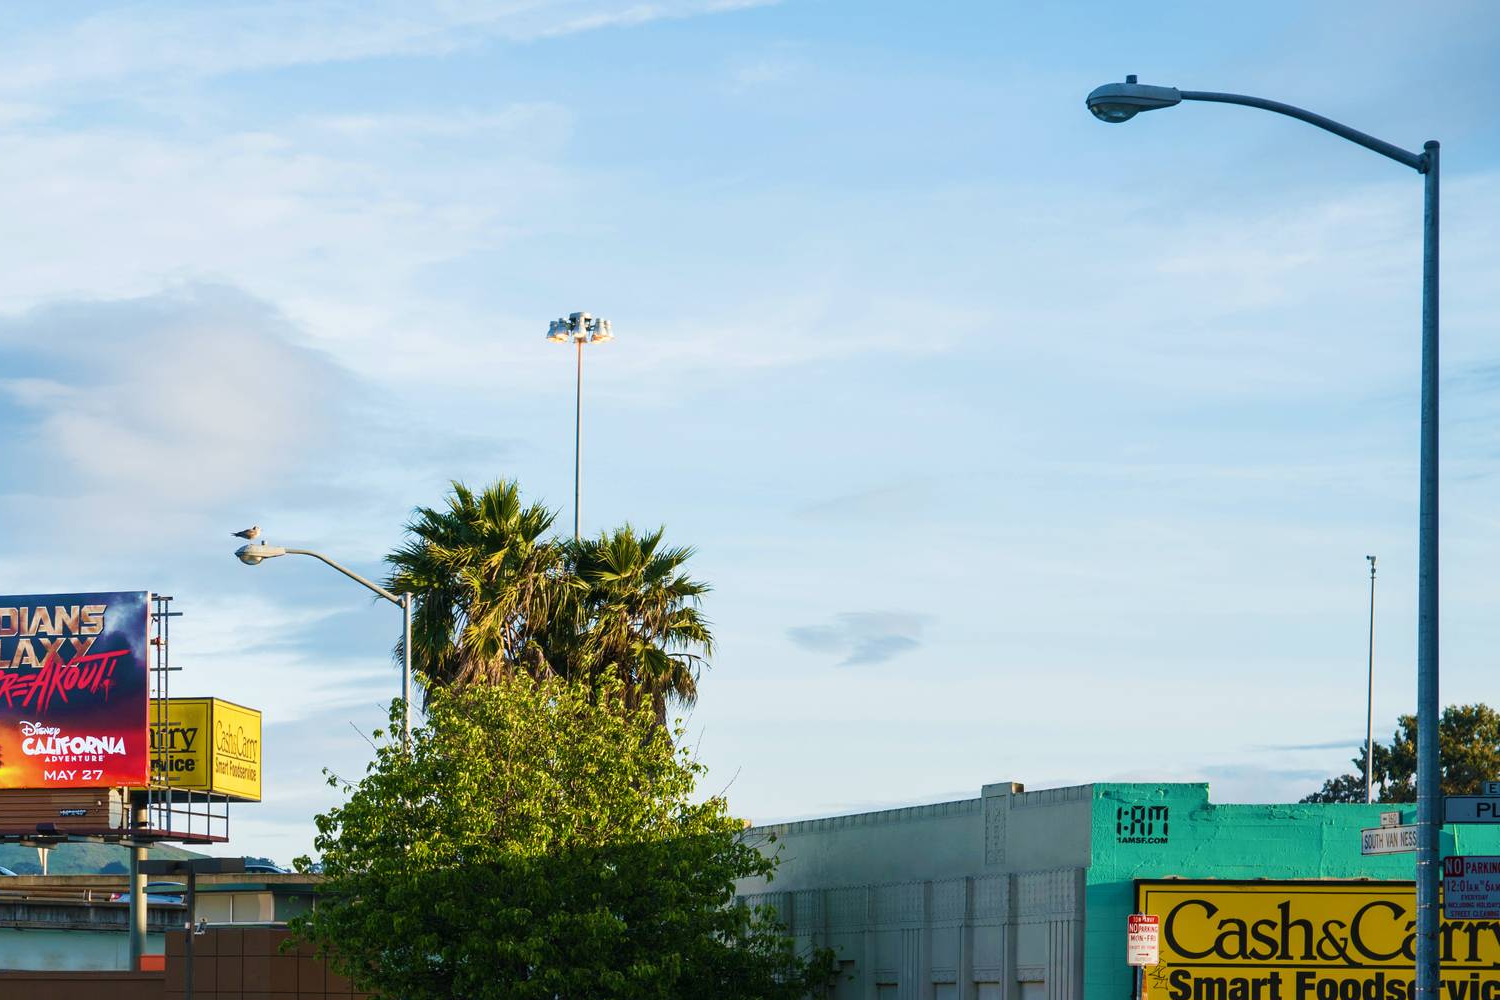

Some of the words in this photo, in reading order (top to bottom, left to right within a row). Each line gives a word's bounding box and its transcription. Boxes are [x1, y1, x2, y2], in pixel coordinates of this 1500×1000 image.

[22, 736, 126, 756] CALIFORNIA
[216, 720, 258, 762] Cash&Carry
[43, 770, 78, 780] MAY
[82, 769, 104, 780] 27
[1364, 832, 1384, 849] SOUTH
[1385, 832, 1399, 848] VAN
[1400, 831, 1417, 847] NESS
[1445, 859, 1461, 874] NO
[1129, 923, 1138, 933] NO
